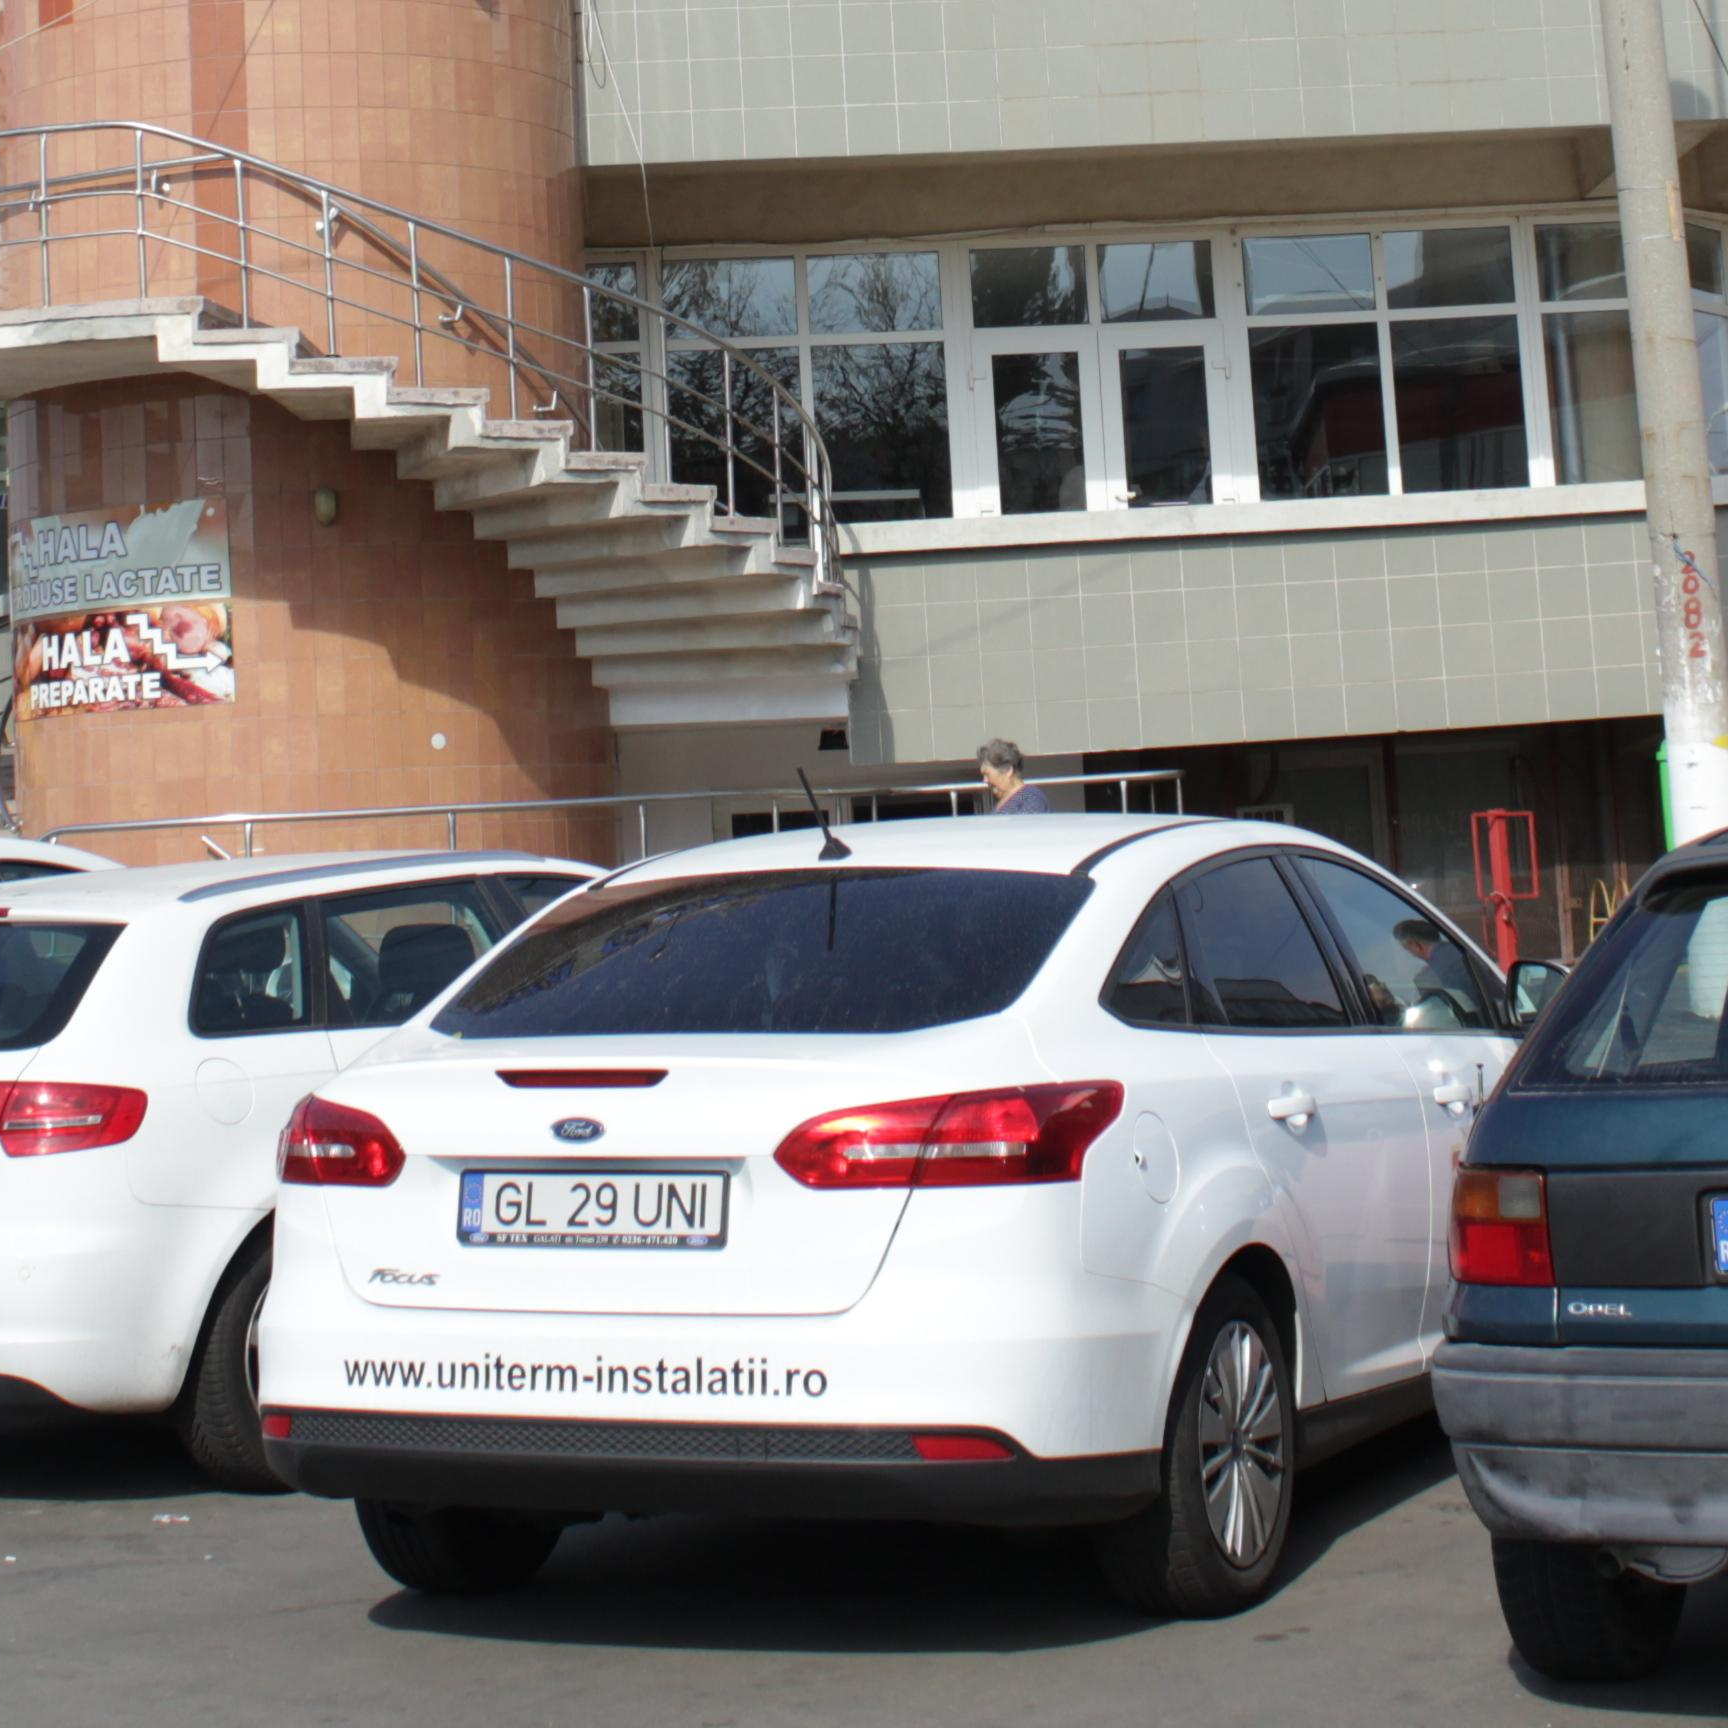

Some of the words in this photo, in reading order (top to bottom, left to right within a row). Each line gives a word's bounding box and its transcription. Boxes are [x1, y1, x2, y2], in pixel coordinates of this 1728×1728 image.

[37, 521, 127, 569] HALA
[84, 562, 222, 601] LACTATE
[42, 628, 131, 671] HALA
[30, 672, 162, 710] PREPARATE
[495, 1182, 546, 1226] GL
[567, 1182, 618, 1227] 29
[633, 1183, 707, 1229] UNI
[344, 1352, 828, 1398] www.uniterm-instalatii.ro
